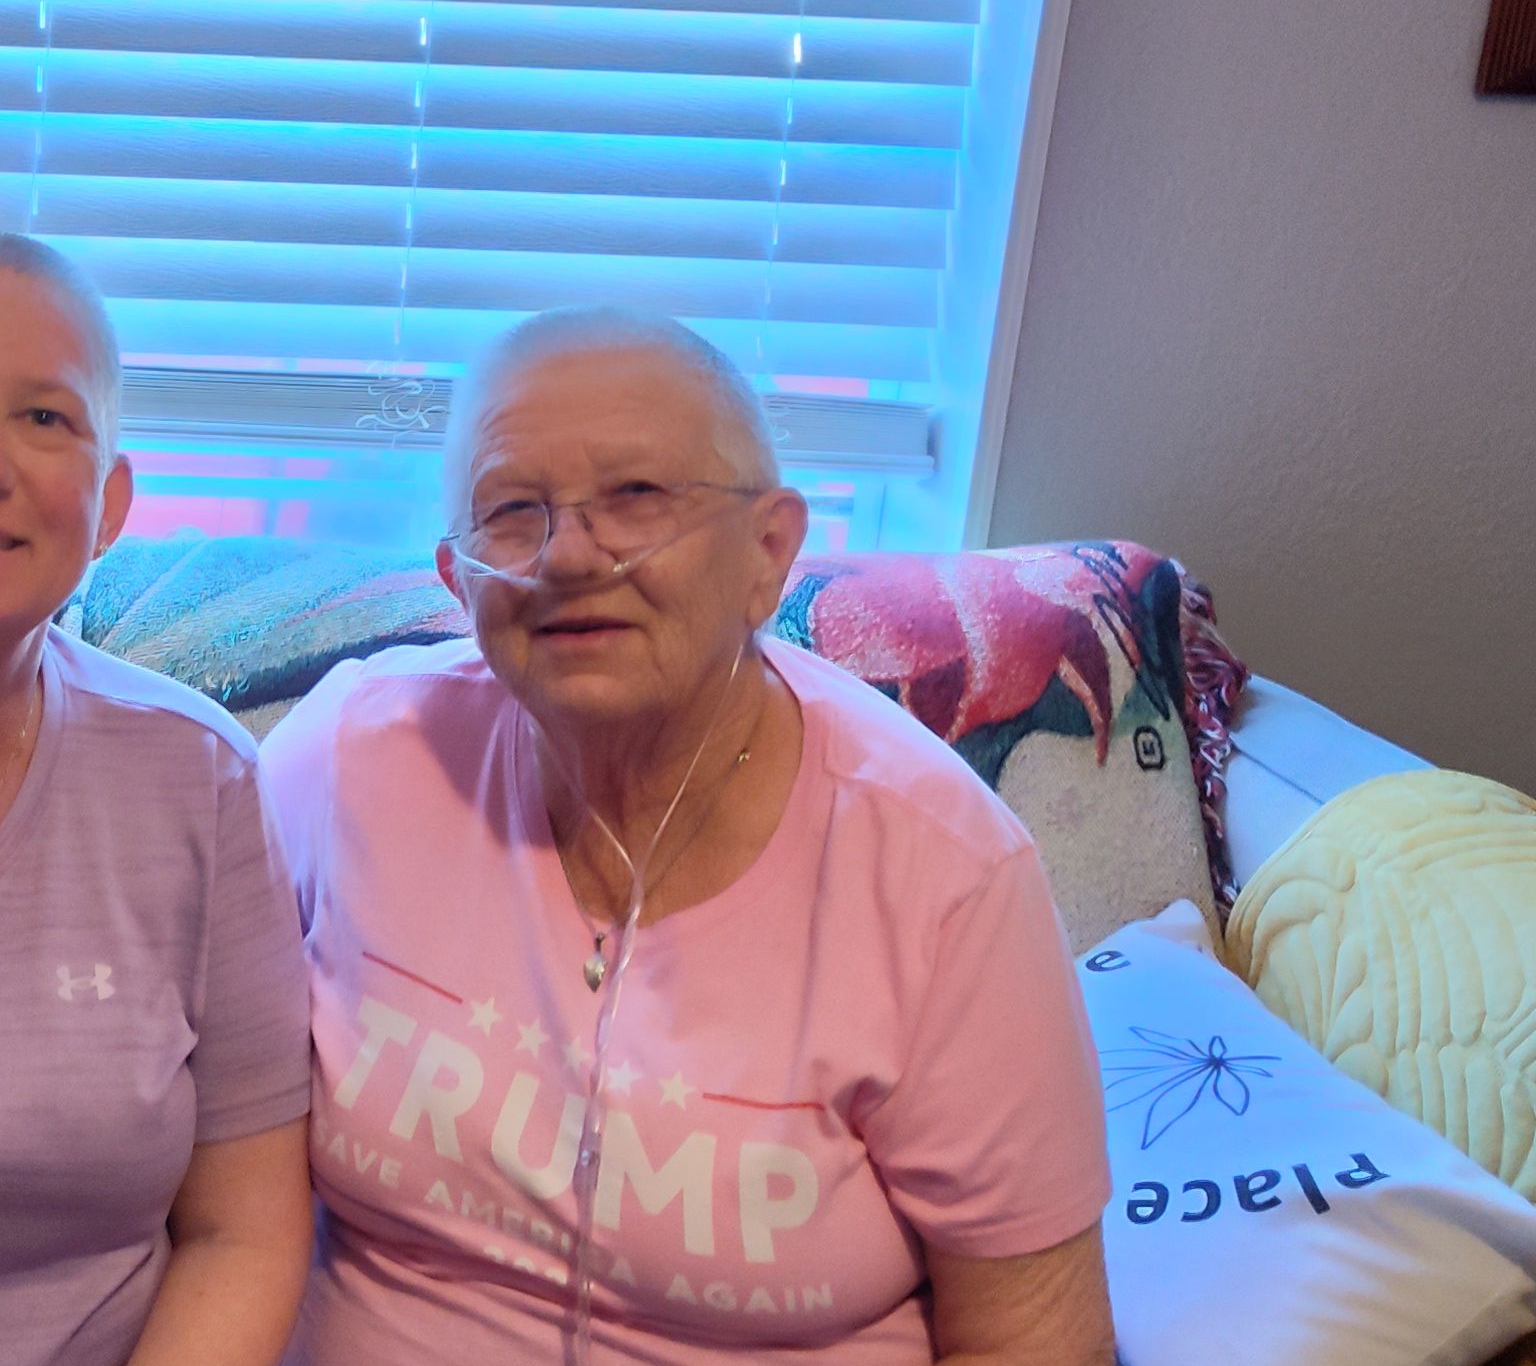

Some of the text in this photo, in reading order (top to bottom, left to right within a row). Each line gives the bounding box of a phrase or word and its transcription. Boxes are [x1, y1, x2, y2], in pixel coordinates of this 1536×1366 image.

[334, 995, 820, 1265] TRUMP
[423, 1179, 637, 1287] AMERIA
[665, 1273, 835, 1314] AGAIN
